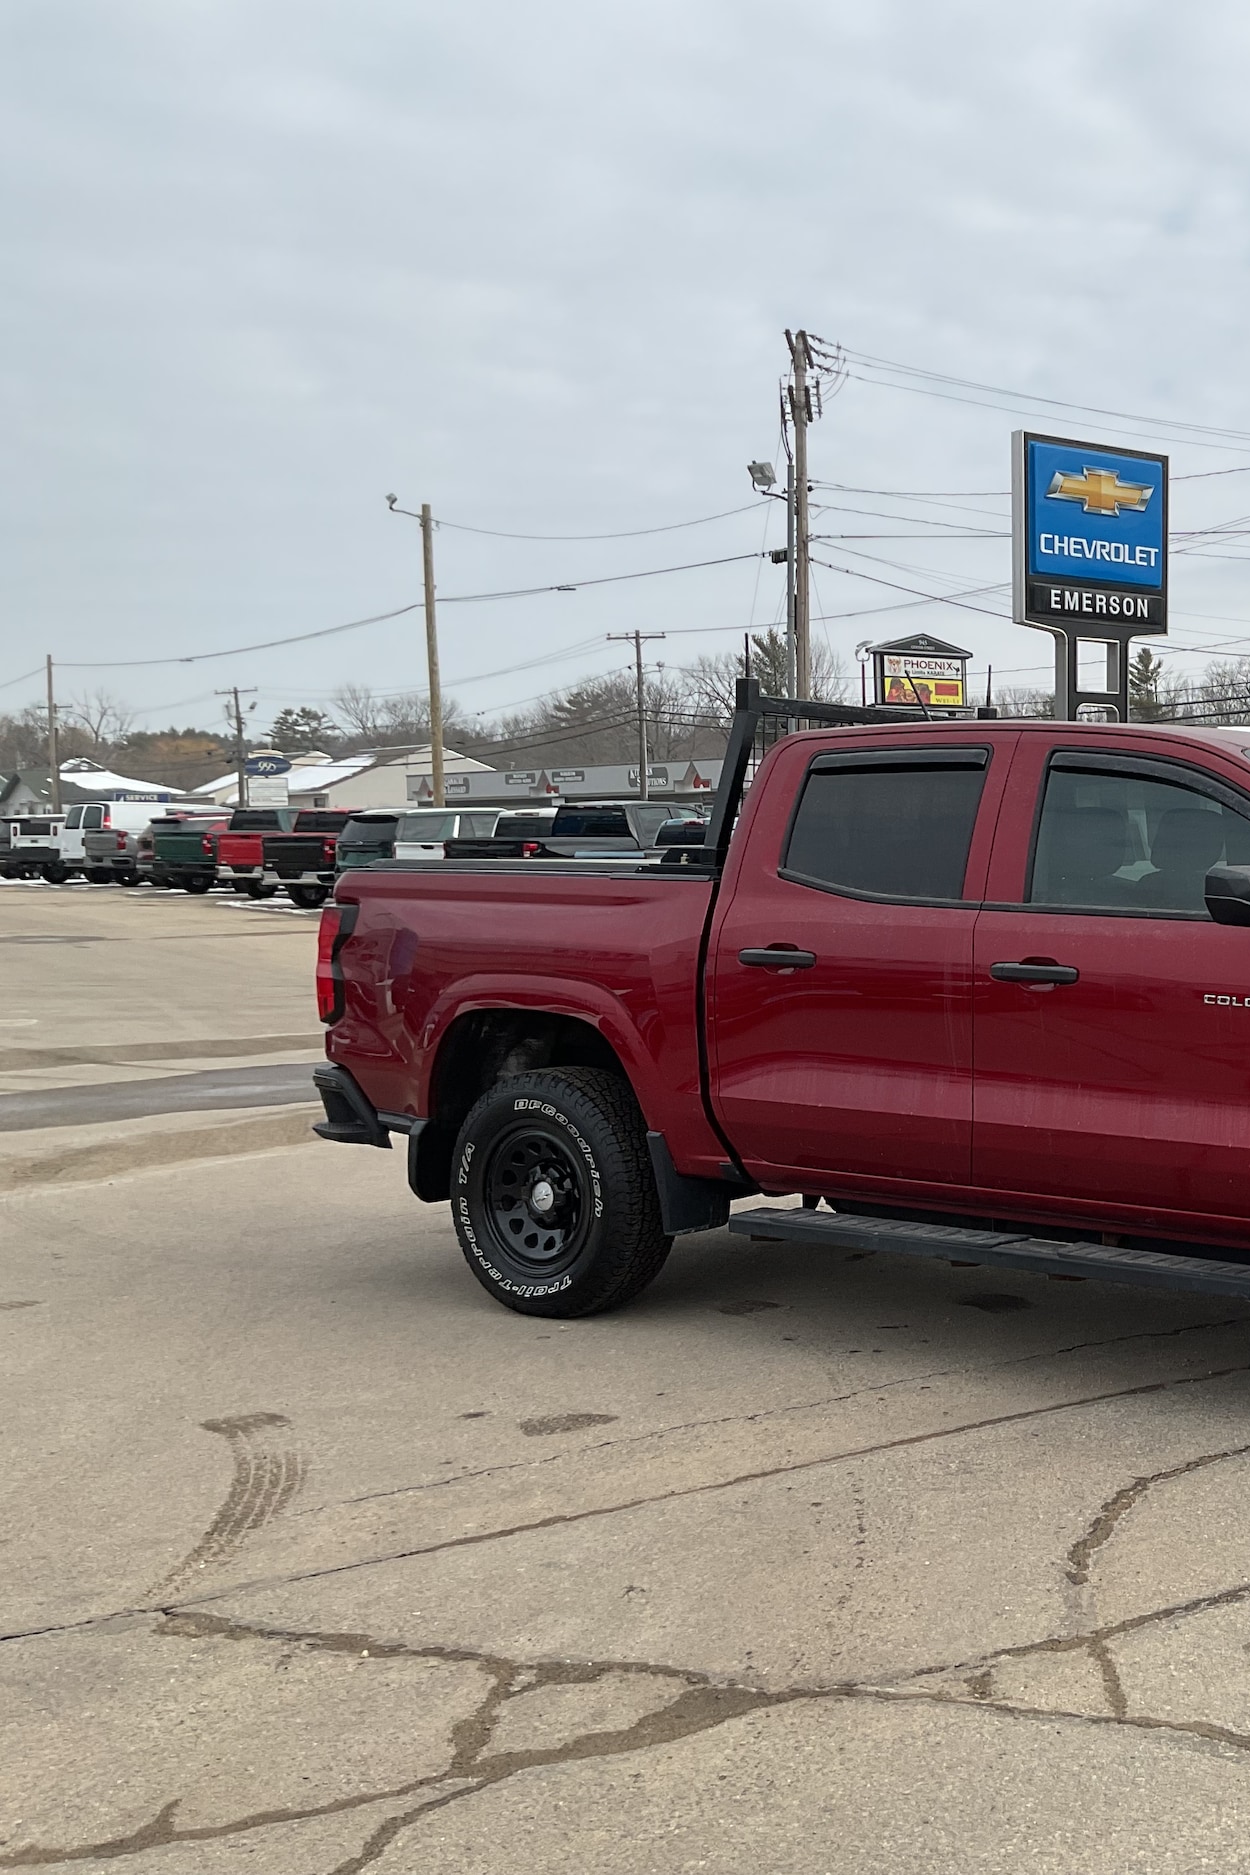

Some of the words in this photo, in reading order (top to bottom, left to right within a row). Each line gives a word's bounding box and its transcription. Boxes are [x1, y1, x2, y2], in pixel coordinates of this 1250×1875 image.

[1040, 533, 1159, 567] CHEVROLET
[1050, 589, 1149, 618] EMERSON
[904, 659, 954, 671] PHOENIX
[458, 1142, 475, 1184] T/A
[514, 1098, 604, 1218] BFGoodrich
[459, 1196, 573, 1298] Trail-Terrain
